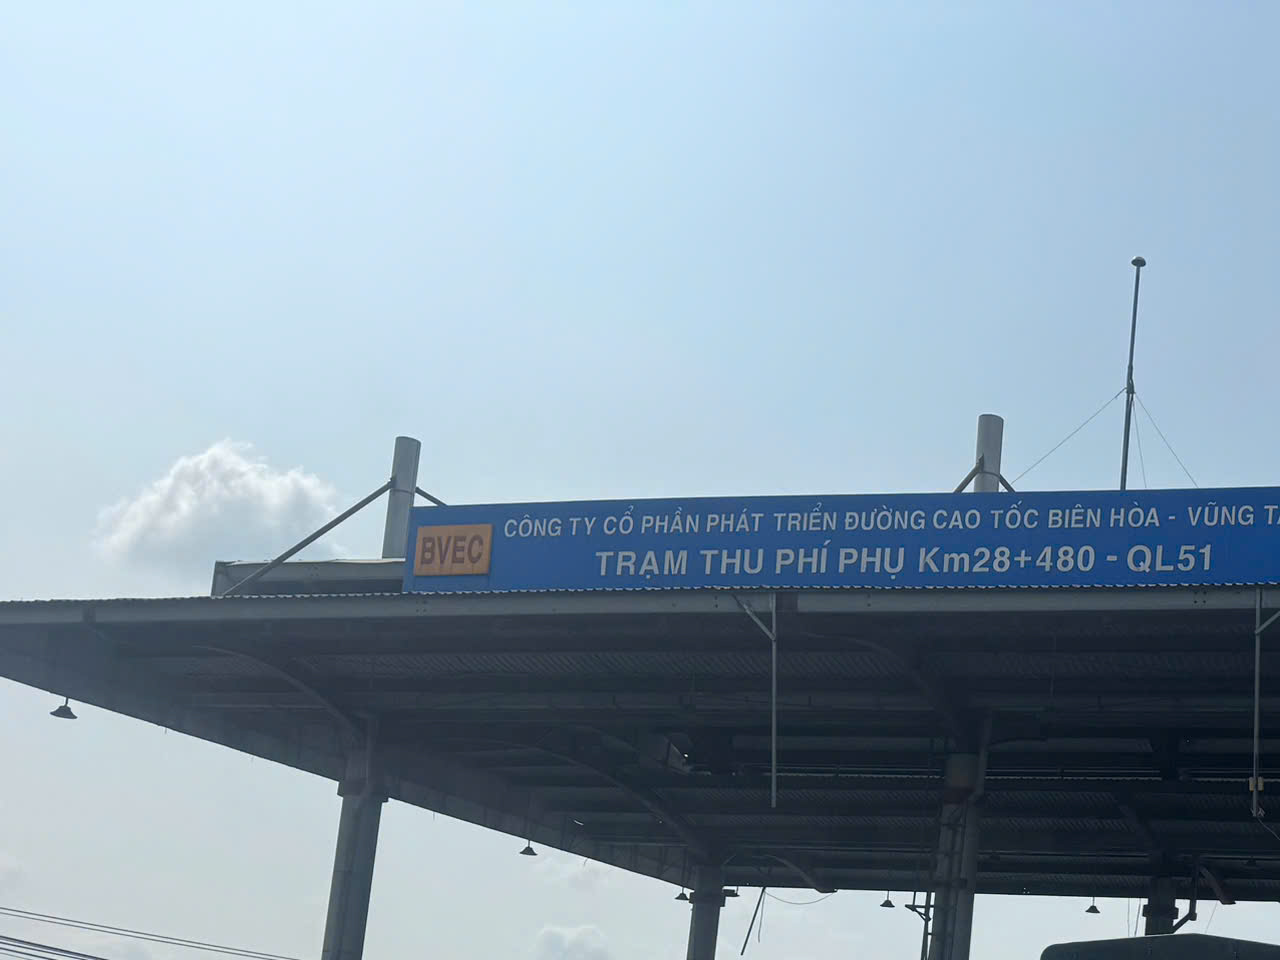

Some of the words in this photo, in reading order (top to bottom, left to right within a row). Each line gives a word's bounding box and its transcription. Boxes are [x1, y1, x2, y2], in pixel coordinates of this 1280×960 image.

[504, 513, 562, 538] CÔNG
[569, 516, 597, 536] TY
[602, 505, 635, 535] CỔ
[641, 505, 700, 534] PHẦN
[706, 508, 764, 533] PHÁT
[773, 502, 837, 532] TRIỂN
[844, 503, 926, 531] ĐƯỜNG
[932, 508, 981, 530] CAO
[990, 501, 1040, 530] TỐC
[1047, 503, 1101, 529] BIÊN
[1110, 501, 1161, 528] HÒA
[1187, 501, 1254, 528] VŨNG
[420, 534, 484, 565] BVEC
[596, 549, 688, 580] TRẠM
[700, 548, 764, 575] THU
[775, 540, 831, 574] PHÍ
[838, 546, 904, 580] PHỤ
[918, 543, 1096, 573] Km28+480
[1126, 544, 1212, 573] QL51
